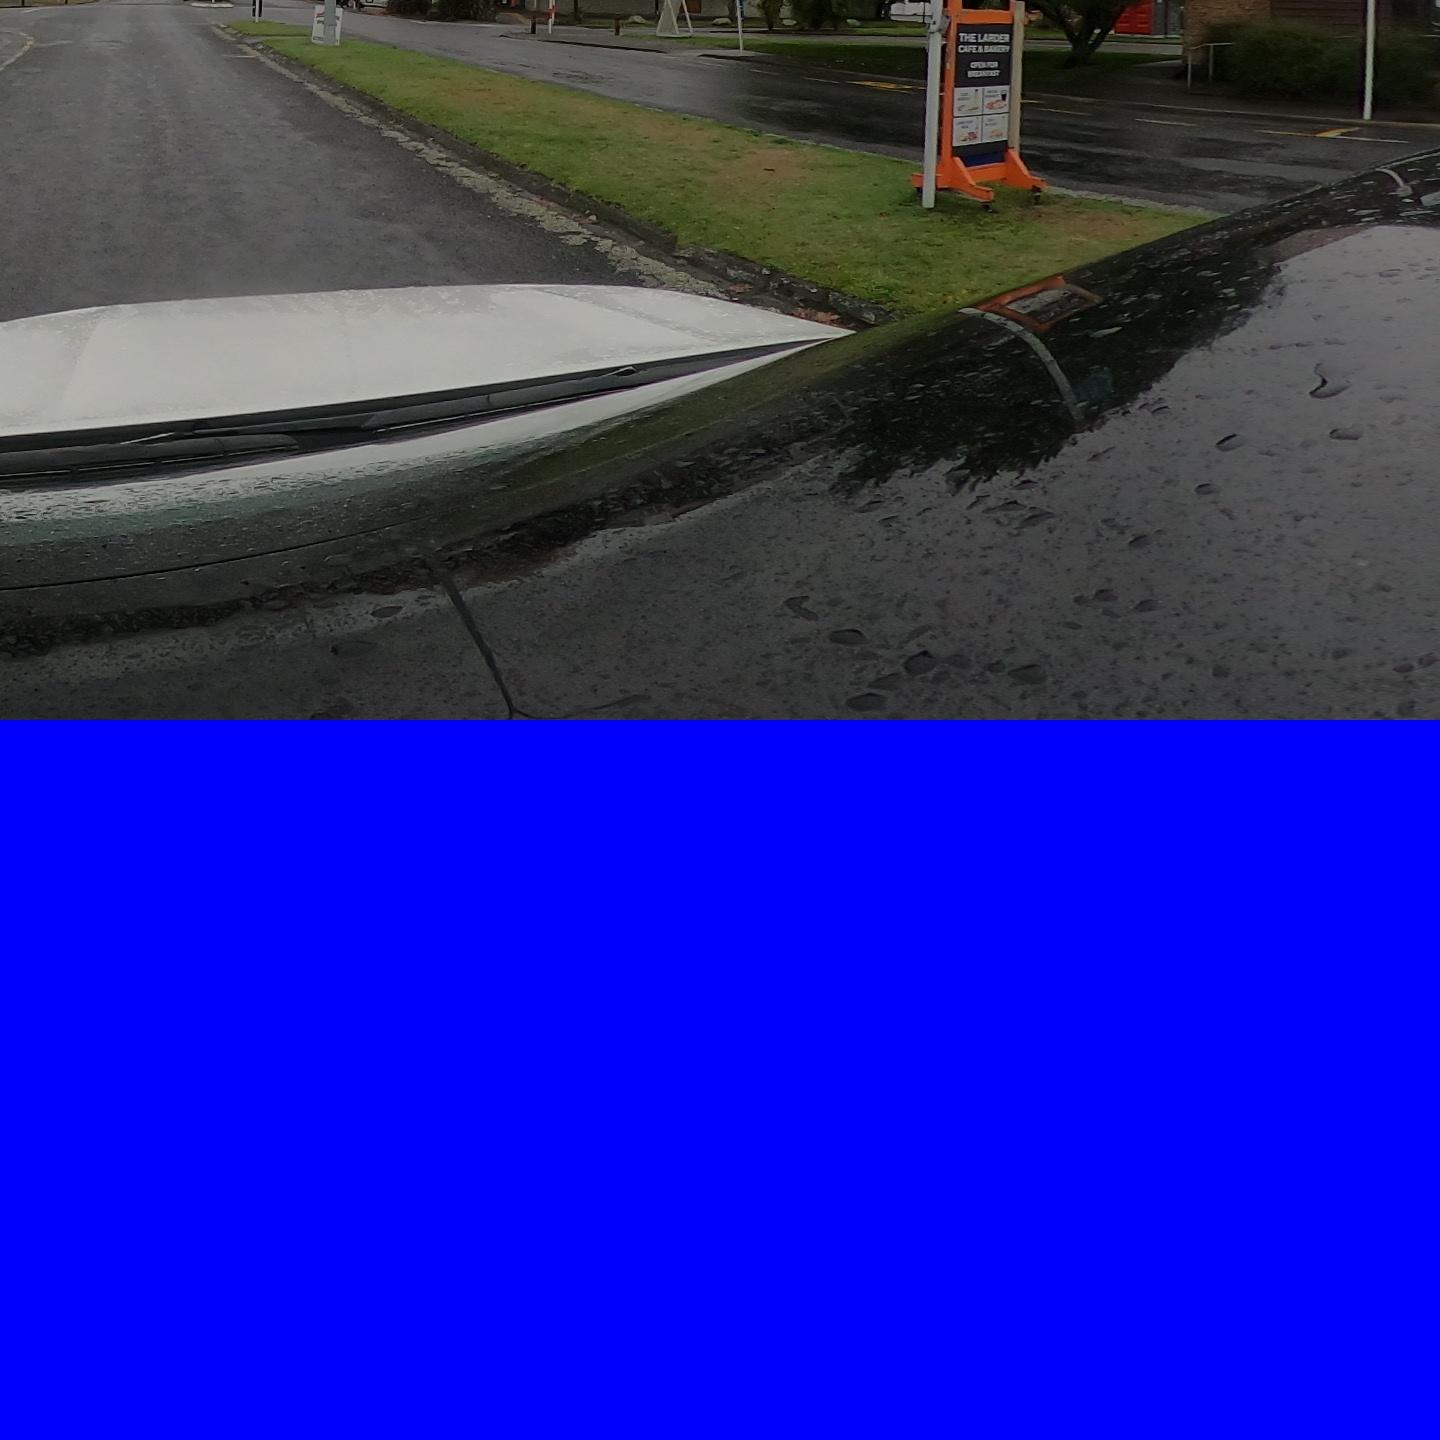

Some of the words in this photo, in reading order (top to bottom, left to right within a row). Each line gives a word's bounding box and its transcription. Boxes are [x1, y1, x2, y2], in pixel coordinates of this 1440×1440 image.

[958, 33, 977, 42] THE
[977, 33, 1010, 42] LARDER
[958, 45, 977, 53] CAFE
